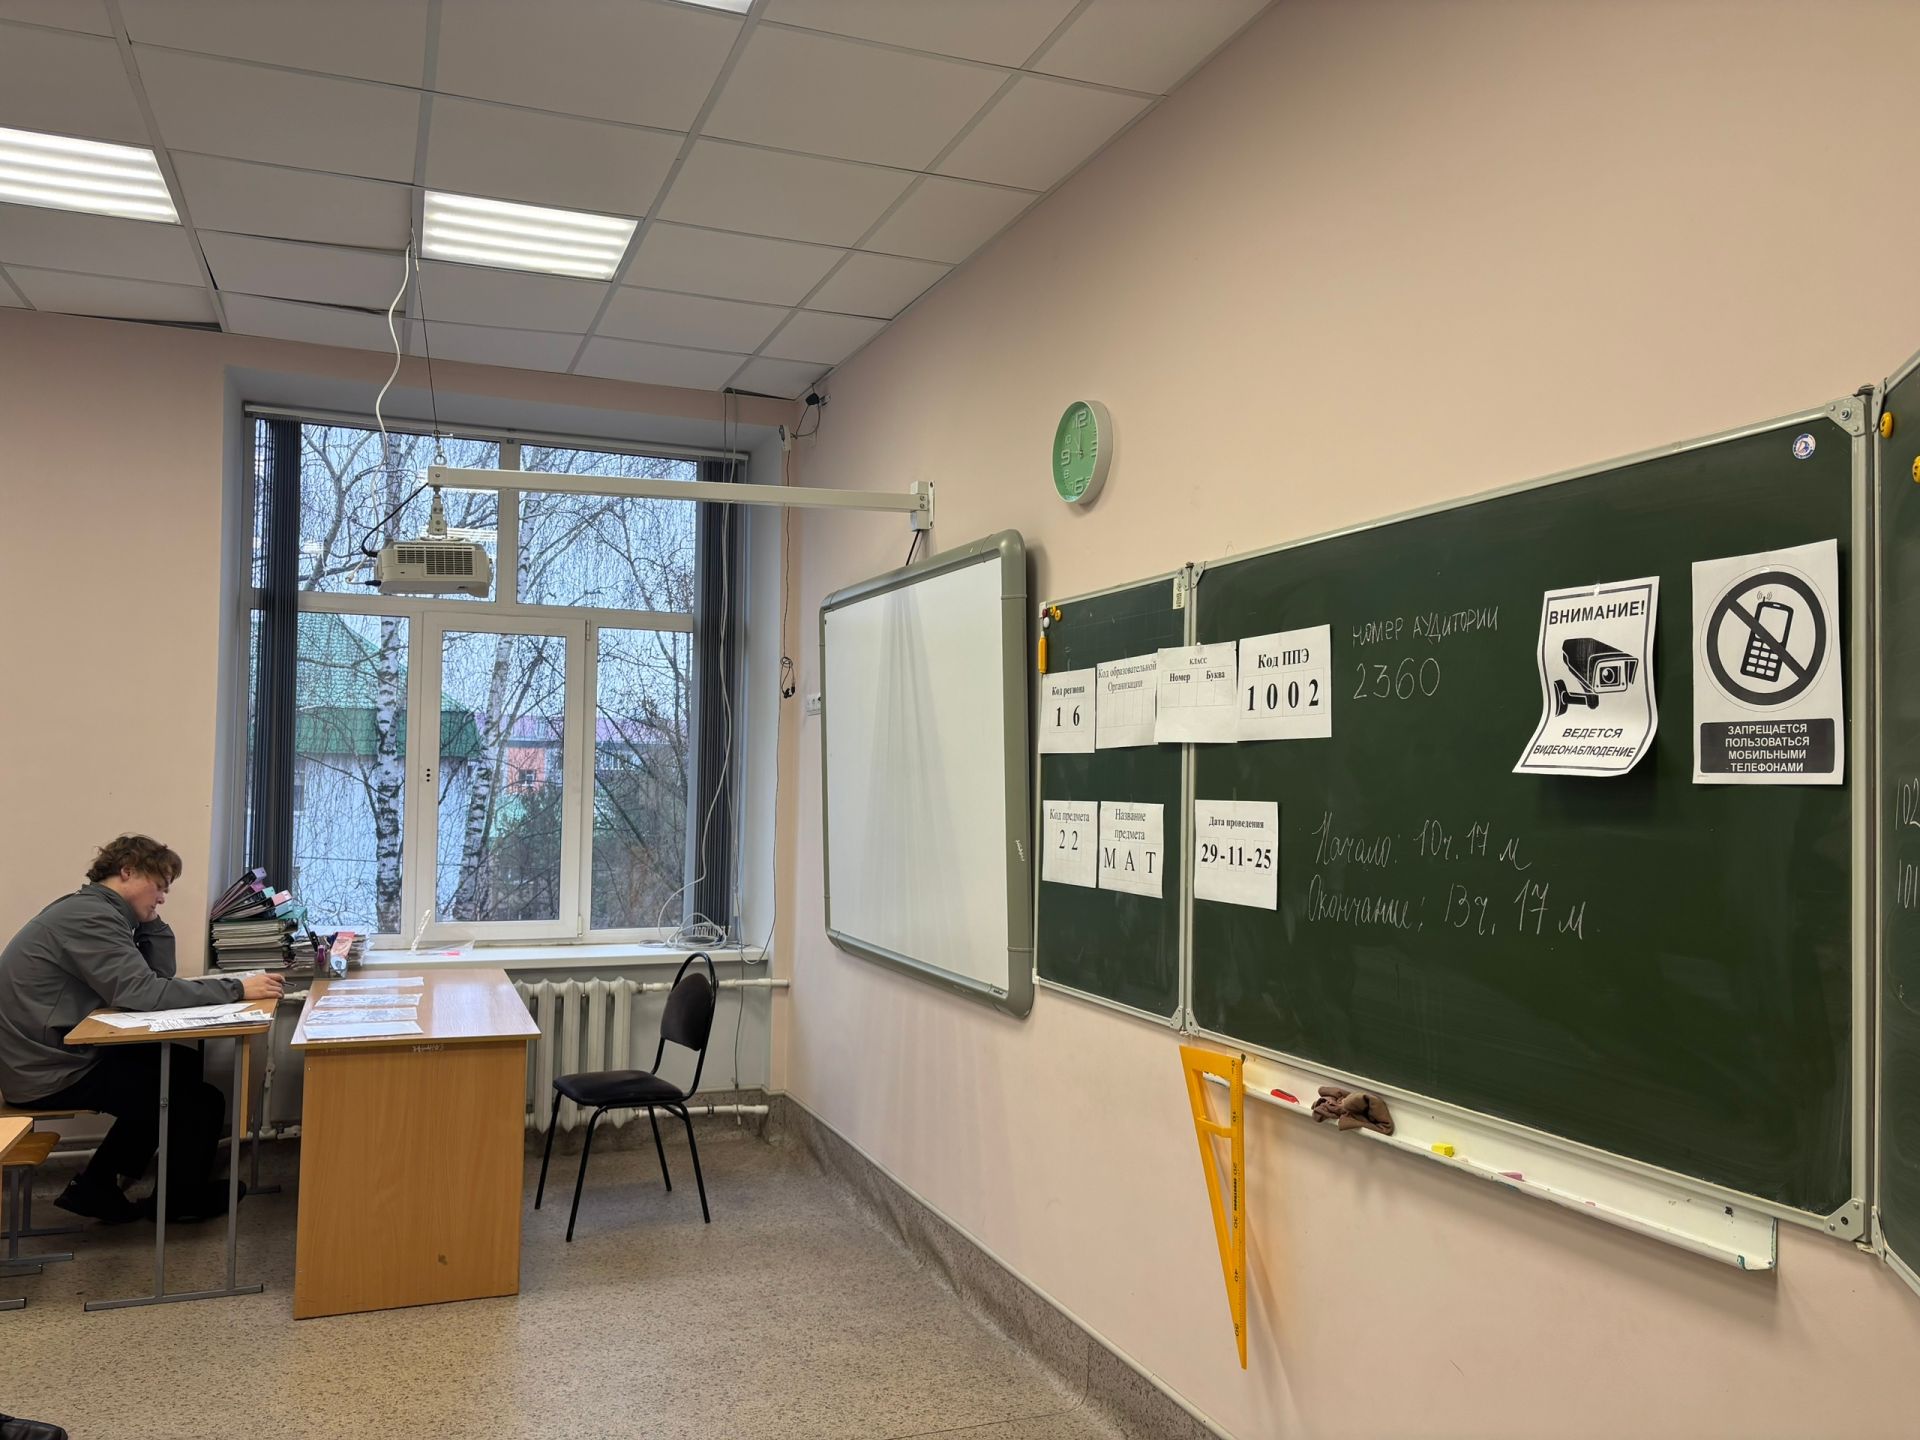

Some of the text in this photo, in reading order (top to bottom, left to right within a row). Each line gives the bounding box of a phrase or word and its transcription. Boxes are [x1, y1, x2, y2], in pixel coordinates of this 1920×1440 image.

[1549, 600, 1645, 625] ВНИМАНИЕ!
[1258, 648, 1310, 669] Код ППЭ
[1098, 661, 1157, 679] Код образовательной
[1169, 670, 1226, 682] Номер Буква
[1353, 657, 1441, 700] 2360
[1052, 685, 1085, 697] Код региона
[1562, 728, 1624, 739] ВЕДЕТСЯ
[1728, 723, 1808, 735] ЗАПРЕЩАЕТСЯ
[1725, 736, 1810, 748] ПОЛЬЗОВАТЬСЯ
[1533, 744, 1636, 758] ВИДЕОНАБЛЮДЕНИЕ
[1728, 749, 1807, 760] МОБИЛЬНЫМИ
[1730, 762, 1804, 772] ТЕЛЕФОНАМИ
[1049, 808, 1090, 823] Код предмета
[1115, 808, 1146, 822] Название
[1209, 816, 1264, 829] Дата проведения
[1114, 829, 1145, 841] предмета
[1467, 821, 1490, 856] 17
[1201, 843, 1272, 869] 29-11-25
[1513, 879, 1549, 935] 17
